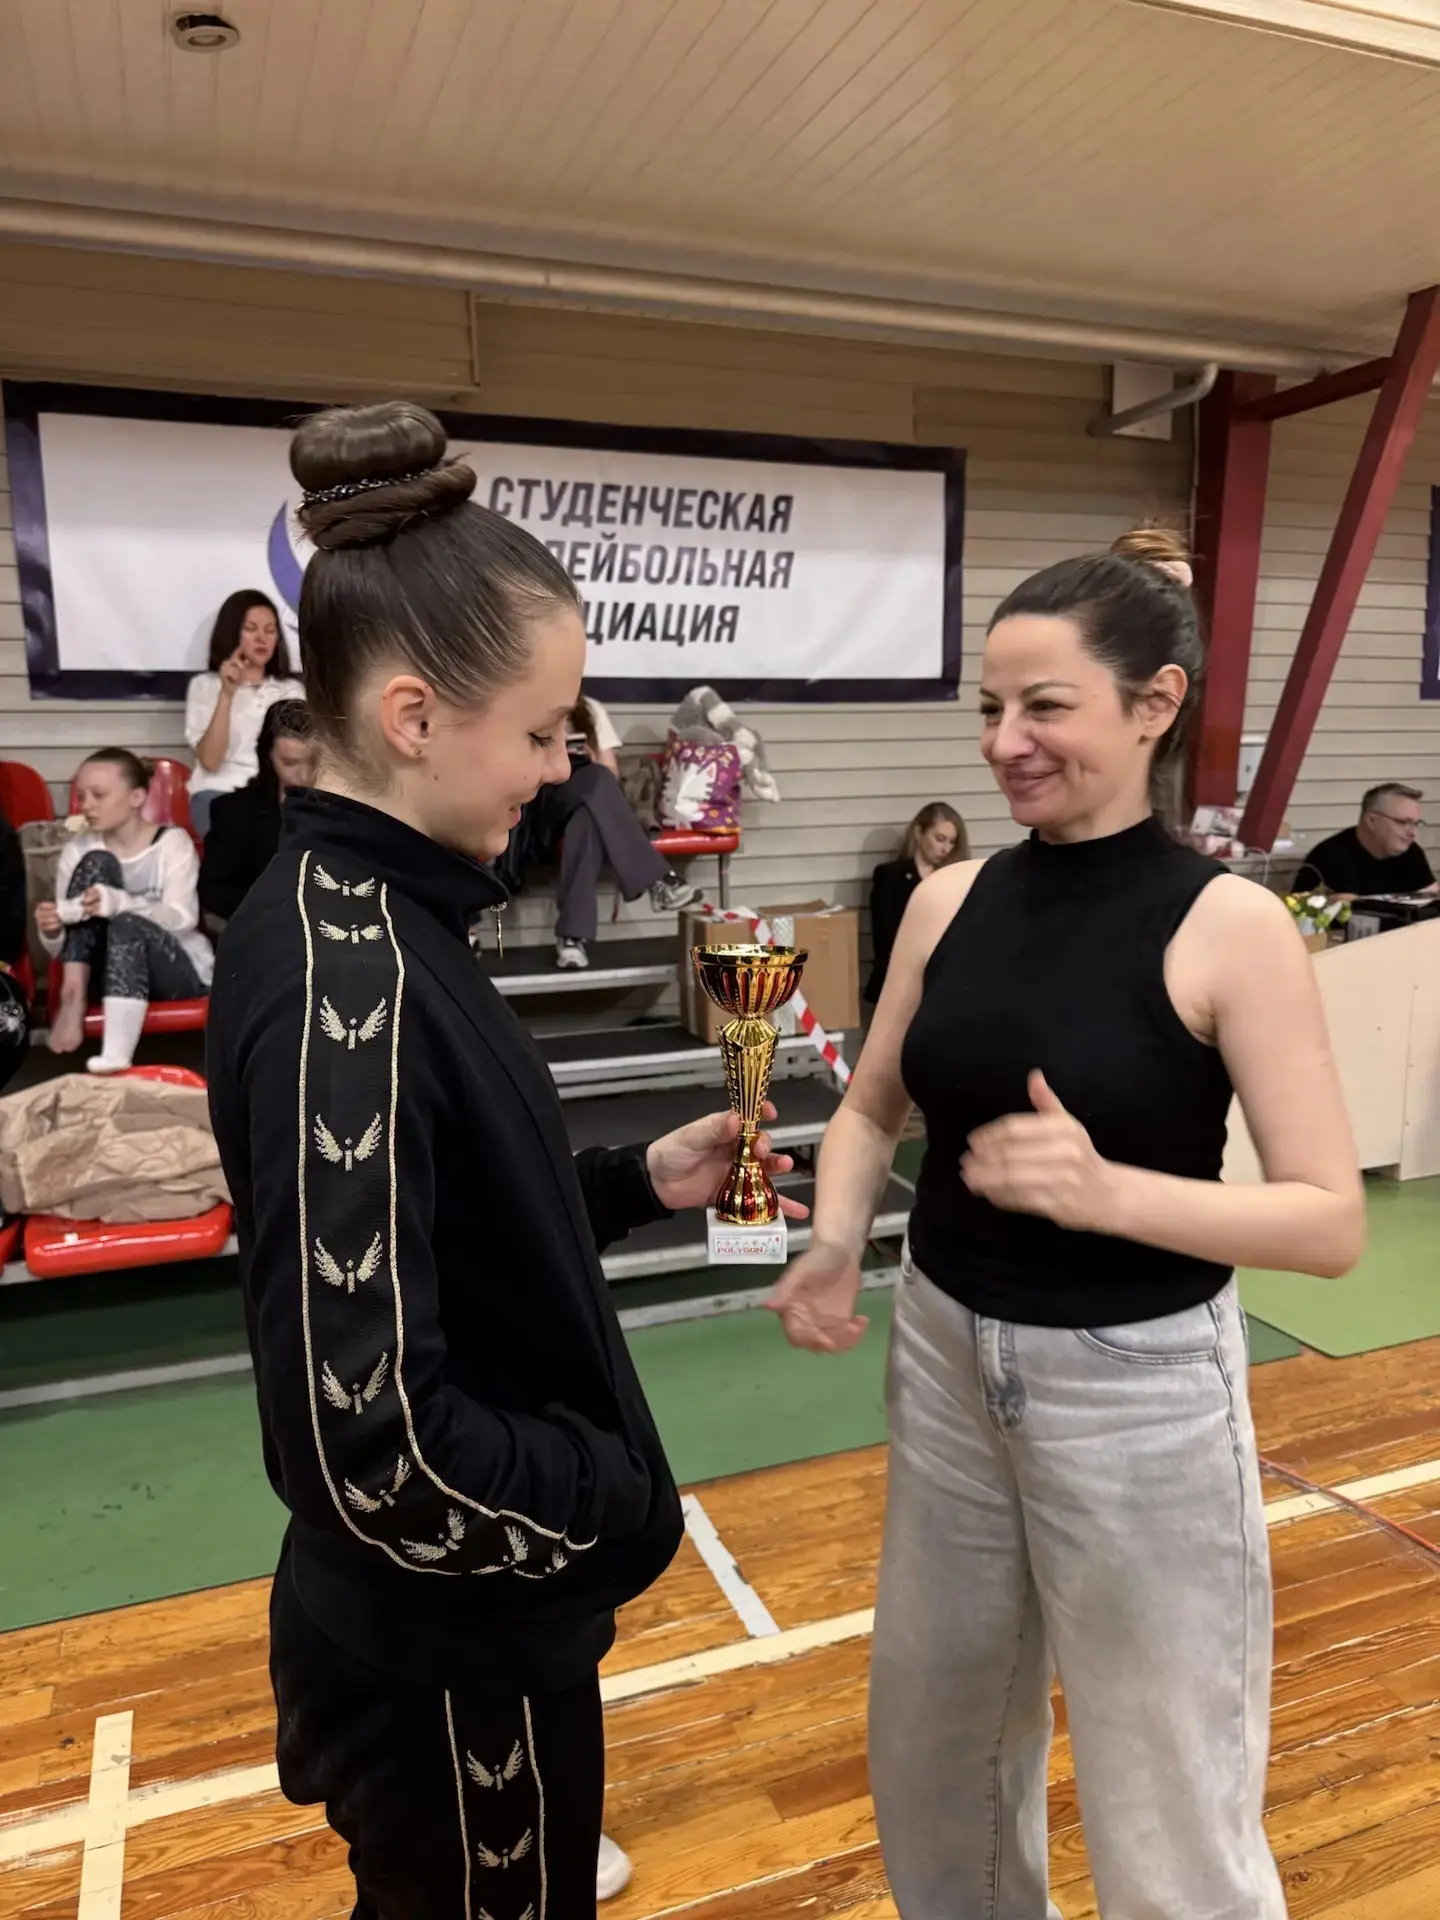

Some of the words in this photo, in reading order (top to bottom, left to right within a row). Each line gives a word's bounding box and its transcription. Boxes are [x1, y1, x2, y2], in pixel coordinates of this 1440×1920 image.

[488, 476, 794, 533] СТУДЕНЧЕСКАЯ
[583, 600, 740, 647] ЦИАЦИЯ
[717, 1246, 764, 1254] POLYGON
